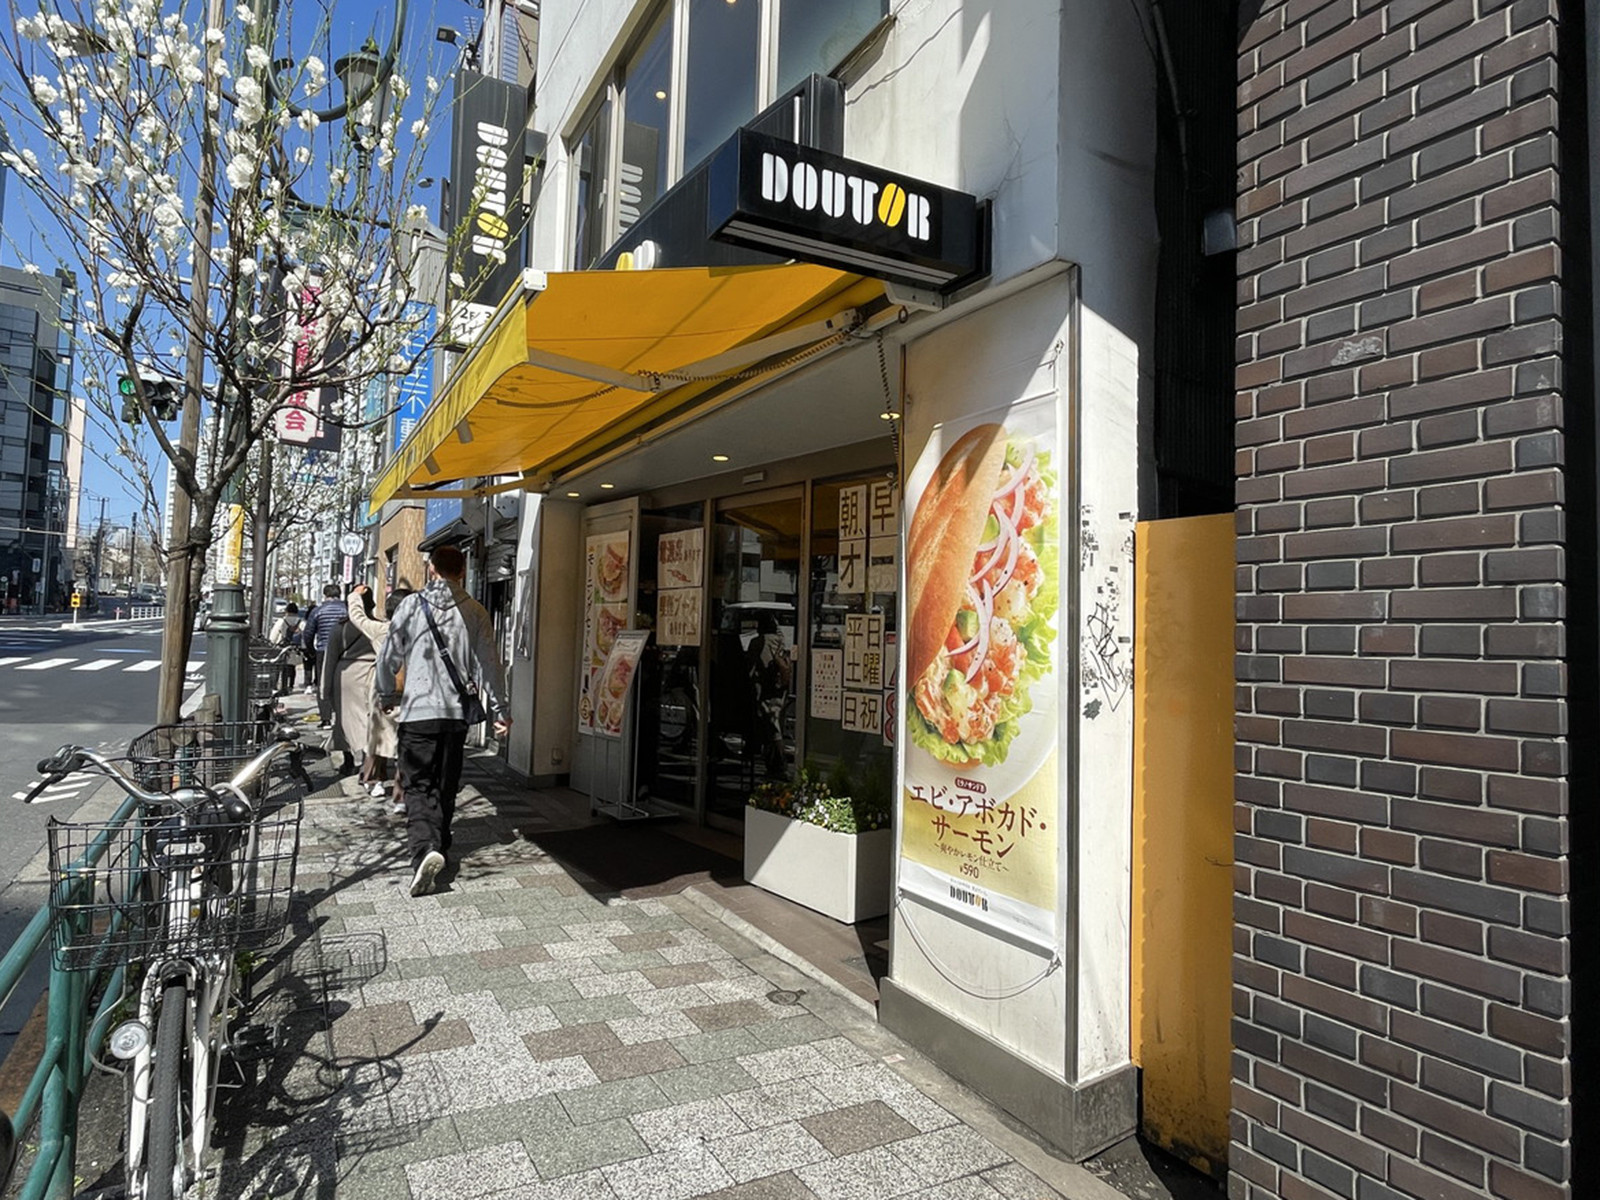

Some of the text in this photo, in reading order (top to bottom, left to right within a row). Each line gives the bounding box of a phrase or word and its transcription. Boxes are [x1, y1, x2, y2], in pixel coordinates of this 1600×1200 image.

[472, 121, 509, 264] DOUTOR
[762, 152, 930, 241] DOUTOR
[847, 617, 881, 649] 平日
[846, 652, 880, 685] 土曜
[844, 696, 879, 730] 日祝
[910, 785, 1047, 837] エビ・アボカド・
[931, 814, 1015, 859] サーモン
[950, 885, 989, 912] DOUTOR
